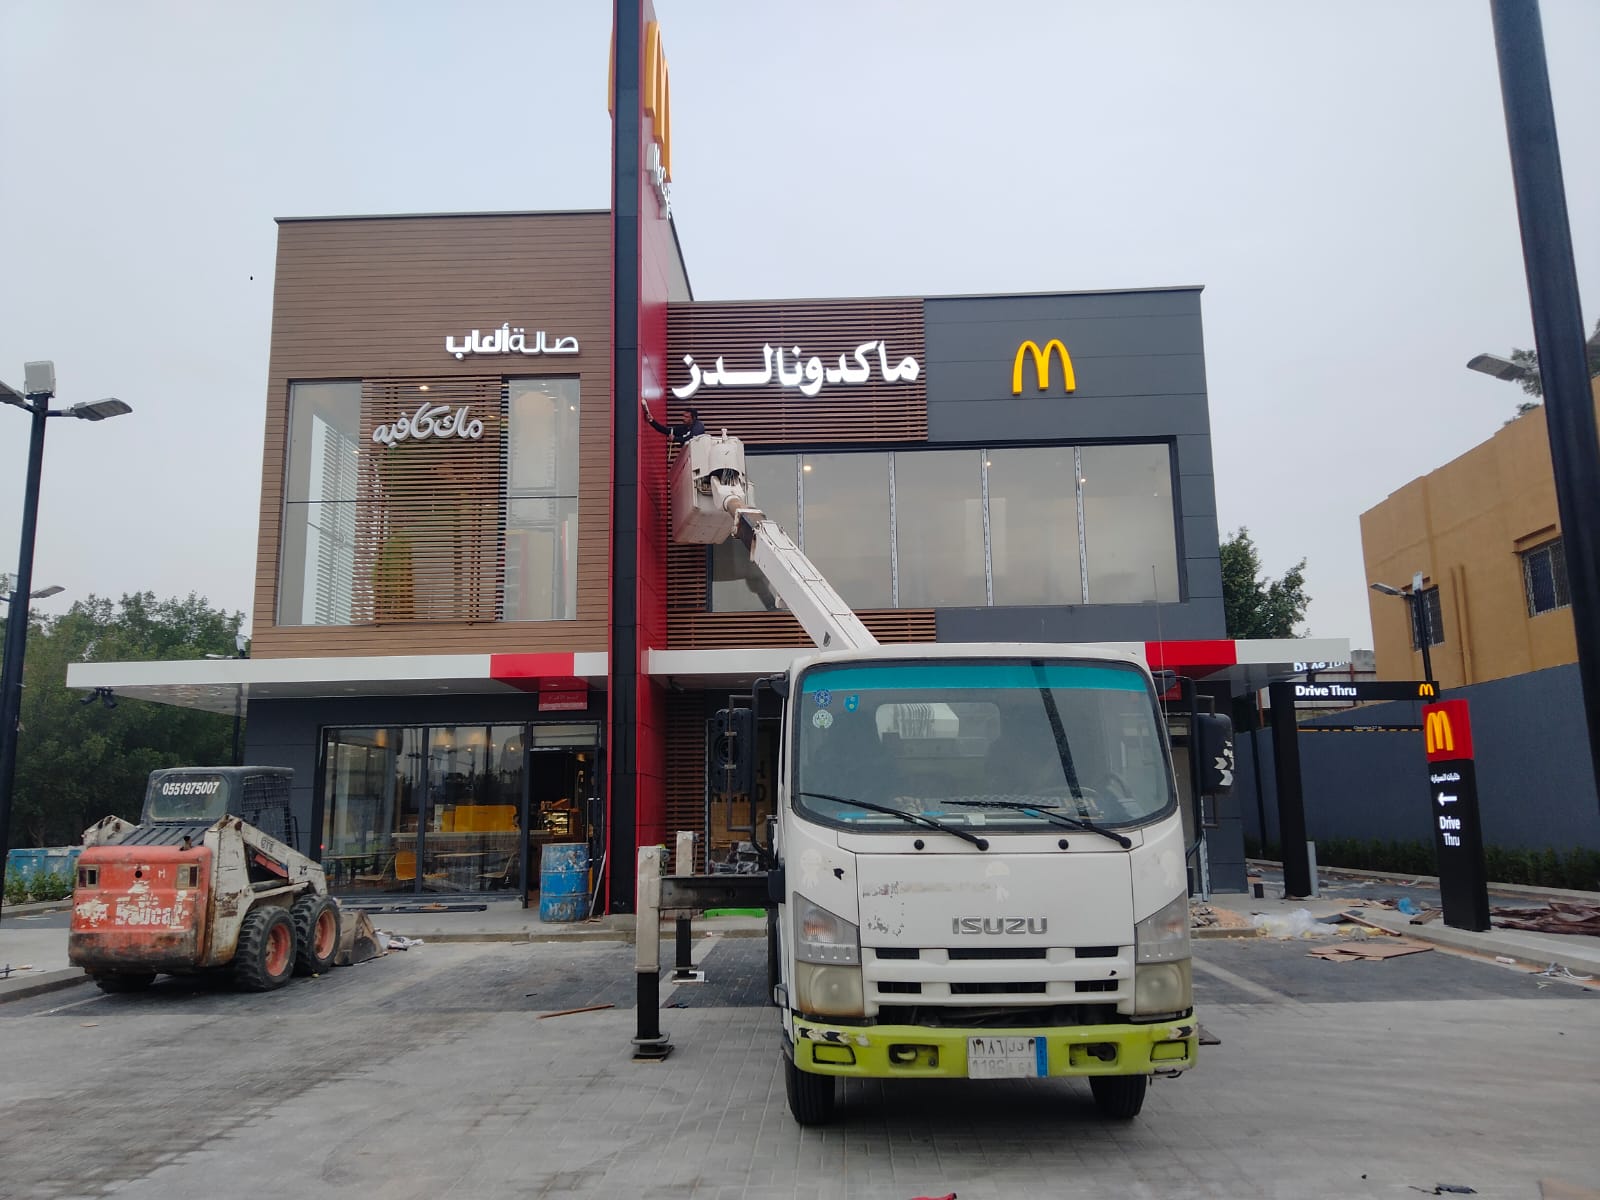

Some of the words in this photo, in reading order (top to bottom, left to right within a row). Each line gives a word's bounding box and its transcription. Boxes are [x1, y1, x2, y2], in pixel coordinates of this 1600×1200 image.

[445, 322, 510, 361] ألعاب
[508, 328, 579, 355] صالة
[671, 340, 921, 398] ماكدونالدز
[373, 402, 450, 448] كافيه
[433, 405, 484, 439] ماك
[1295, 685, 1329, 696] Drive
[1328, 684, 1357, 696] Thru
[162, 781, 220, 796] 0551975007
[1439, 816, 1461, 830] Drive
[1443, 832, 1461, 847] Thru
[952, 917, 1048, 935] ISUZU
